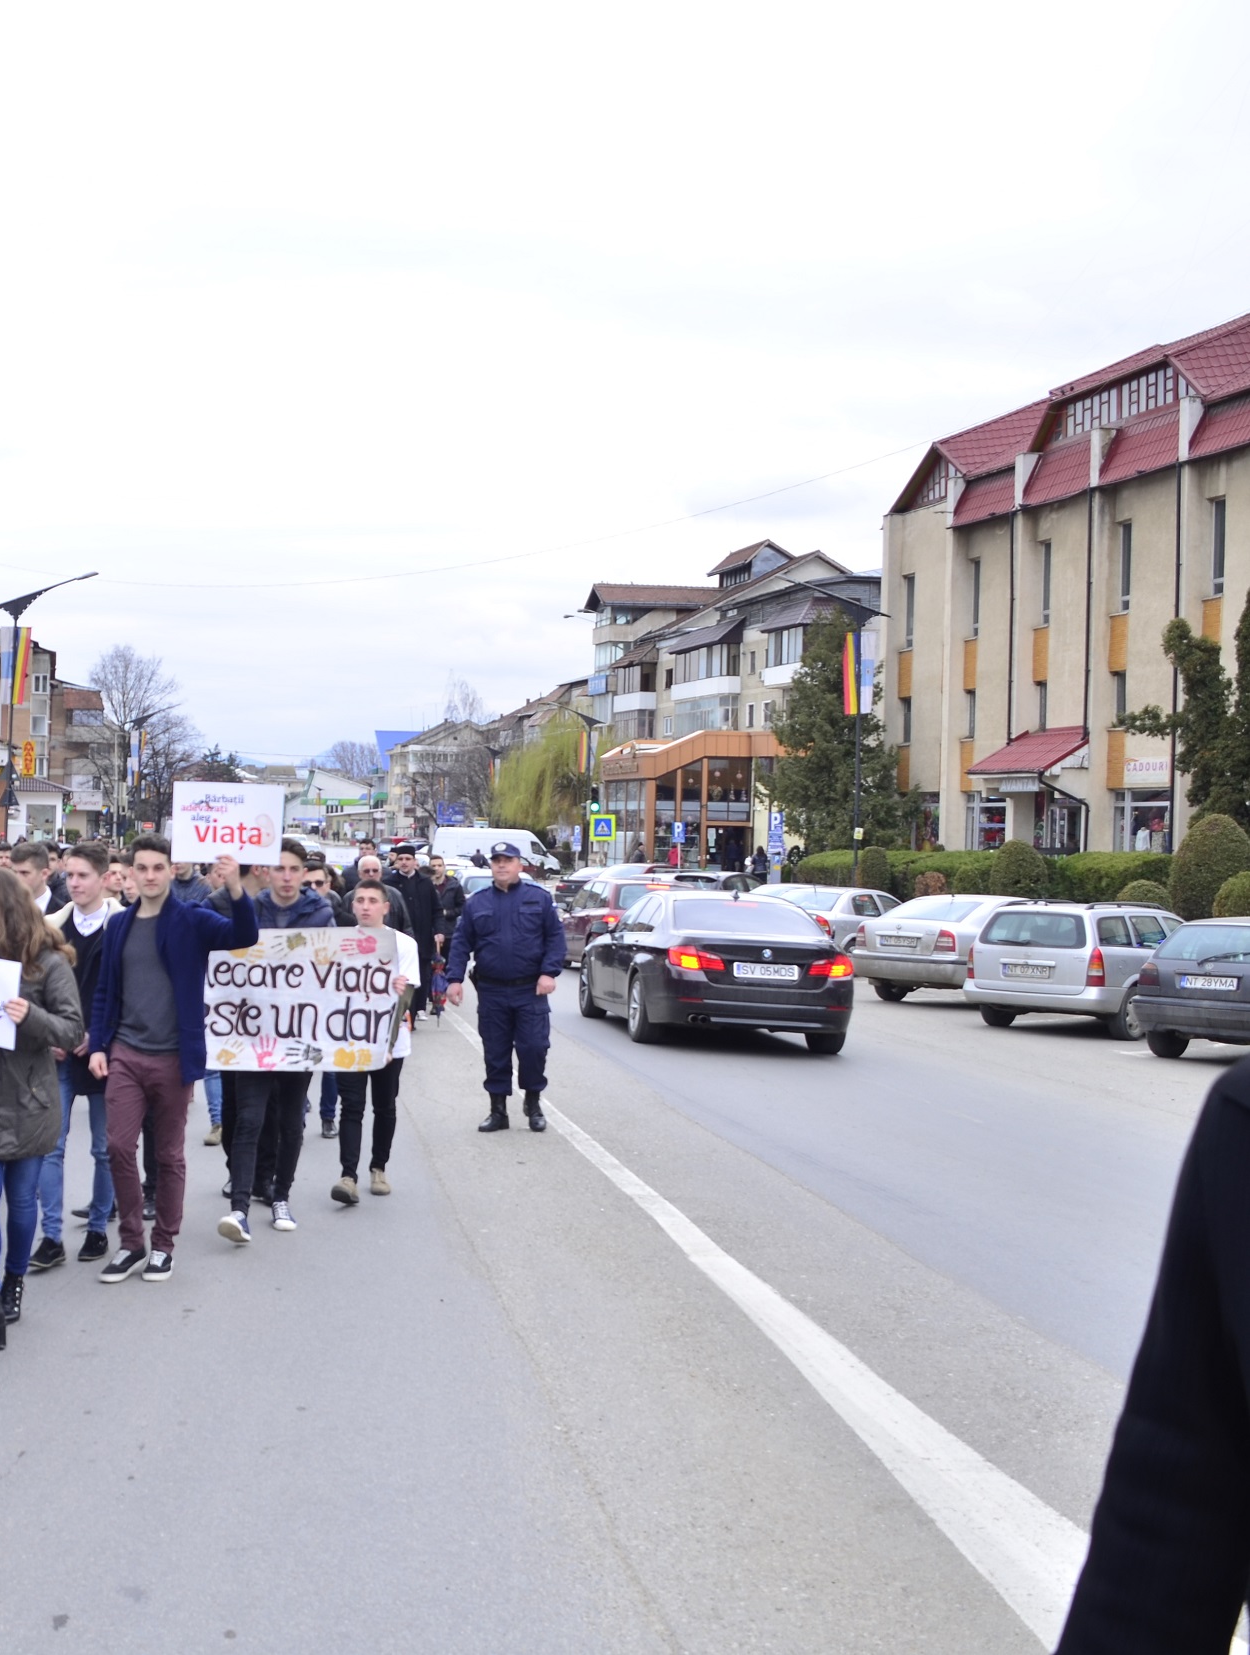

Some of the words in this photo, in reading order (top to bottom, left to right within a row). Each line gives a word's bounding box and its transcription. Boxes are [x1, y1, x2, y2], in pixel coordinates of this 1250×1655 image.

[1126, 760, 1168, 773] CADOURI
[191, 812, 211, 823] aleg
[771, 812, 782, 831] P
[194, 818, 263, 851] viața
[674, 821, 683, 838] P
[741, 965, 755, 976] SV
[1007, 965, 1018, 973] NT
[1185, 977, 1198, 987] NT
[271, 1002, 318, 1041] un
